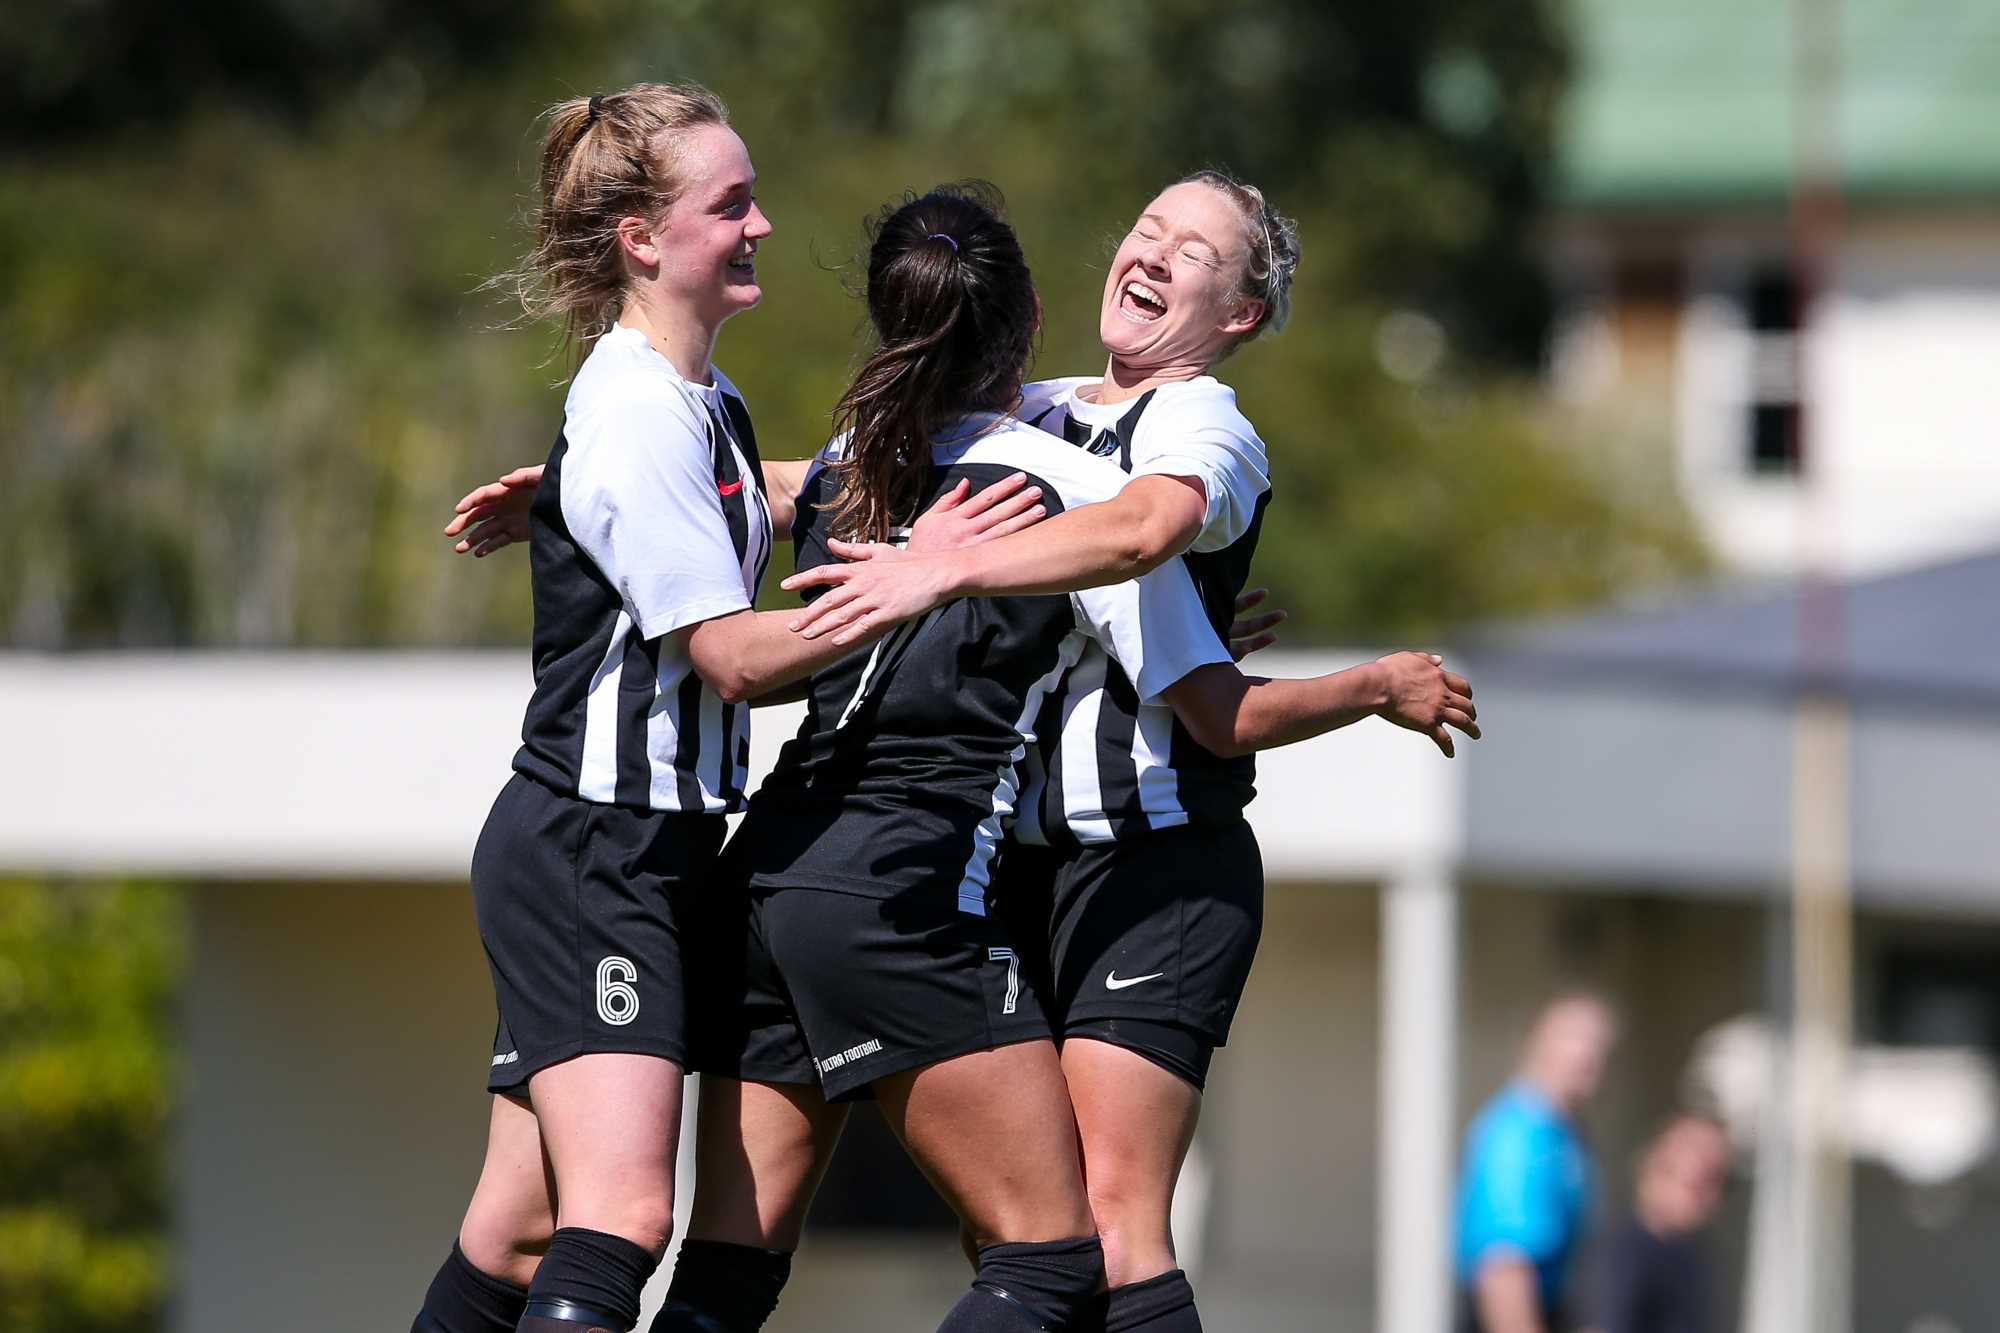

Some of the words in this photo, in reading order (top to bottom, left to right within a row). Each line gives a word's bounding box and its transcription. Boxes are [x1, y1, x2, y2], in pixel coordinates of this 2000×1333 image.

[596, 955, 640, 1026] 6
[988, 947, 1020, 1014] 7
[821, 1053, 846, 1073] ULTRA
[843, 1038, 883, 1063] FOOTBALL
